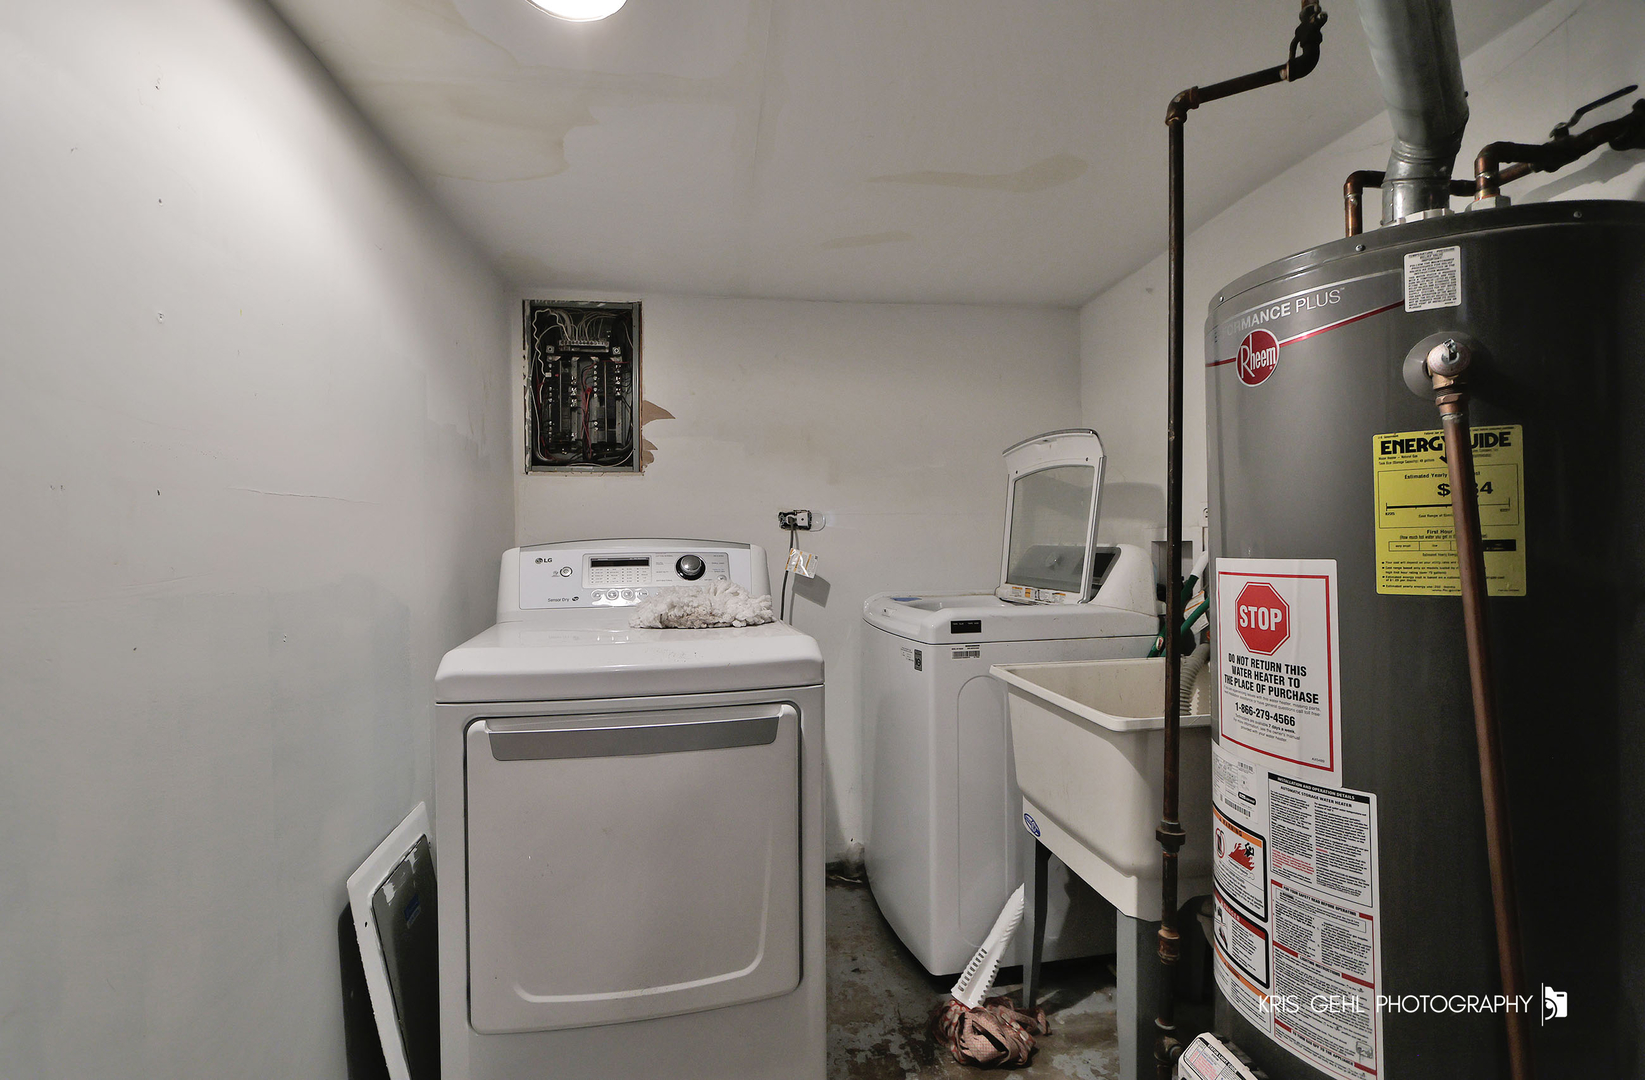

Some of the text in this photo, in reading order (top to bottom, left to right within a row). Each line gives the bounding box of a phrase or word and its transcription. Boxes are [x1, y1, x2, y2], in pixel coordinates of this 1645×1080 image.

[1295, 289, 1341, 313] PLUS
[1240, 333, 1276, 379] Rheem
[1240, 604, 1283, 631] STOP
[1228, 652, 1307, 677] DO NOT RETURN THIS
[1231, 665, 1301, 689] WATER HEATER TO
[1224, 674, 1233, 686] THE
[1234, 677, 1254, 692] PLACE
[1256, 682, 1266, 694] OF
[1268, 686, 1320, 705] PURCHASE
[1235, 702, 1296, 727] 1-866-279-4566
[1277, 777, 1303, 788] INSTALLATION
[1312, 785, 1336, 796] OPERATION
[1336, 791, 1356, 801] DETAILS
[1301, 791, 1319, 800] STORAGE
[1320, 796, 1334, 804] WATER
[1335, 800, 1352, 808] HEATER
